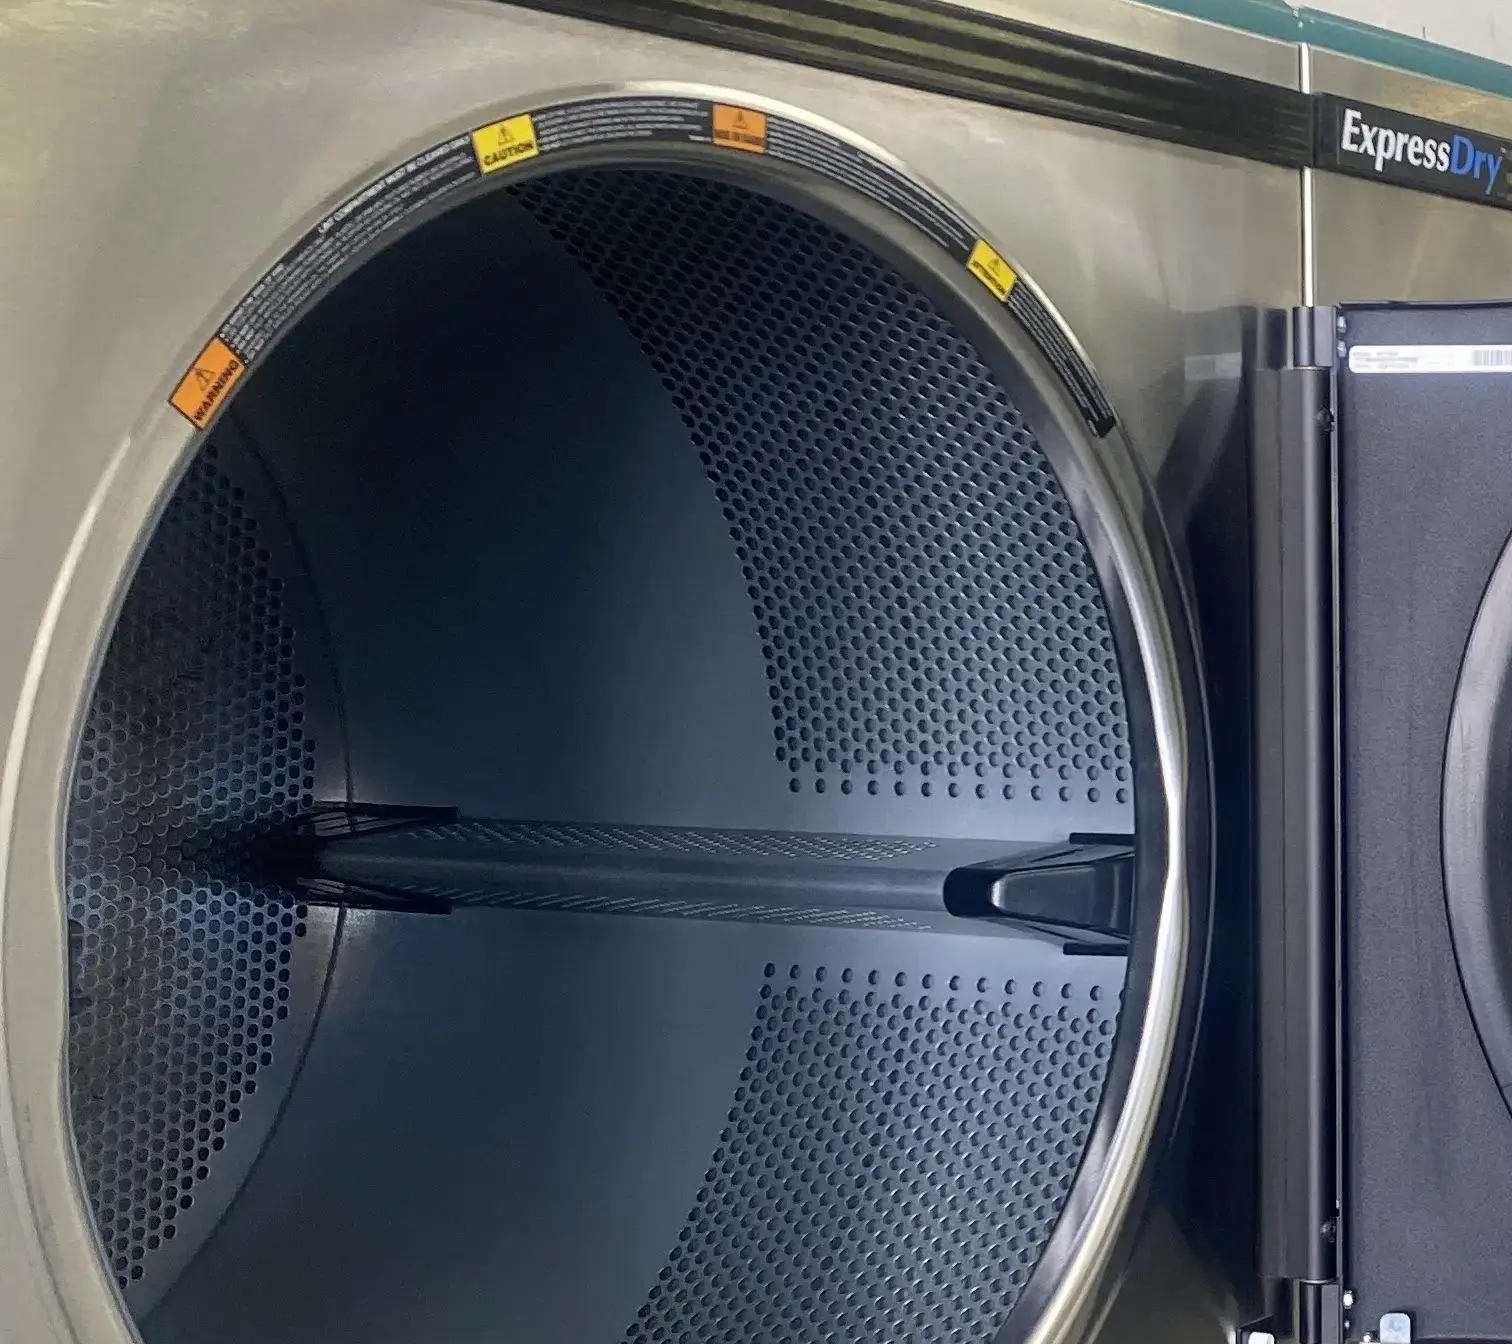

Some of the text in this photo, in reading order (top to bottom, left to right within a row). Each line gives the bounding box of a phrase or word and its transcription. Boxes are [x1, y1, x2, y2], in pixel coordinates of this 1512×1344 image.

[483, 141, 533, 166] CAUTION
[1341, 108, 1502, 196] ExpressDry
[193, 358, 239, 421] WARNING
